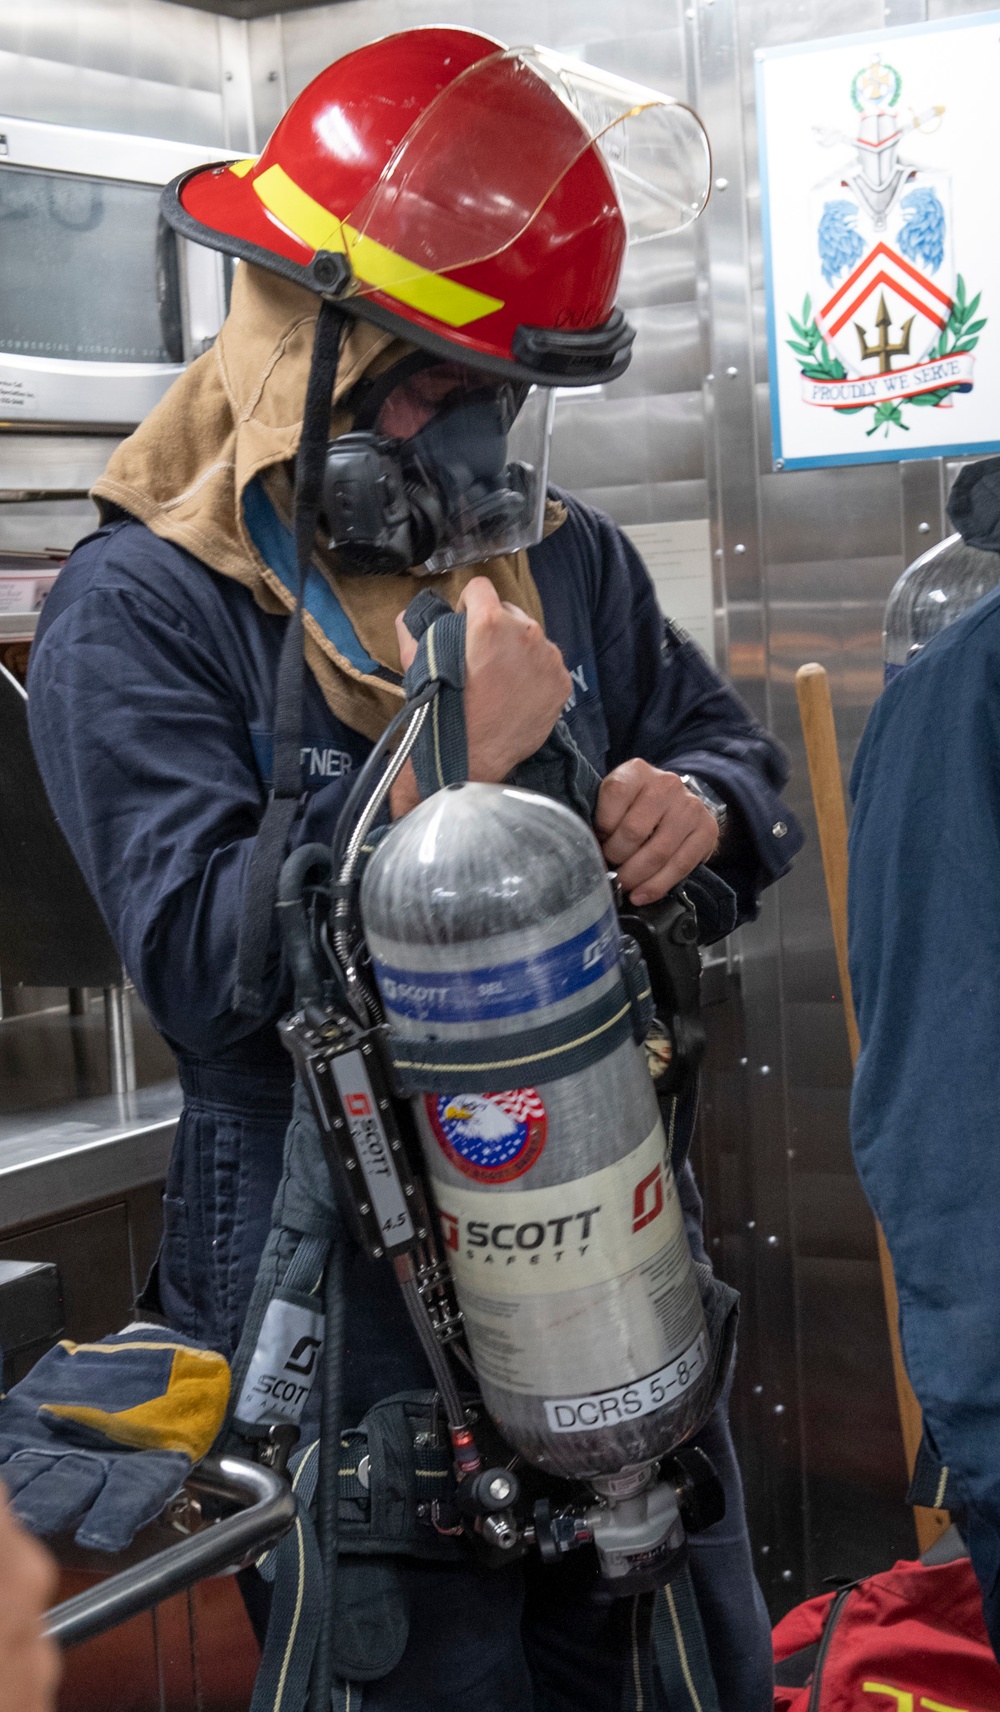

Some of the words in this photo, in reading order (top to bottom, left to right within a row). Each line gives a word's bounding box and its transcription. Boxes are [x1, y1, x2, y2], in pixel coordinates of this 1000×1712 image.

[812, 381, 877, 400] PROUDLY
[882, 375, 910, 392] WE
[914, 360, 960, 384] SERVE
[300, 747, 352, 776] TNER
[397, 983, 450, 1006] SCOTT
[382, 1211, 407, 1231] 4.5
[467, 1205, 602, 1249] SCOTT
[466, 1244, 590, 1265] SAFETY
[252, 1374, 311, 1405] SCOT
[555, 1391, 642, 1427] DCRS
